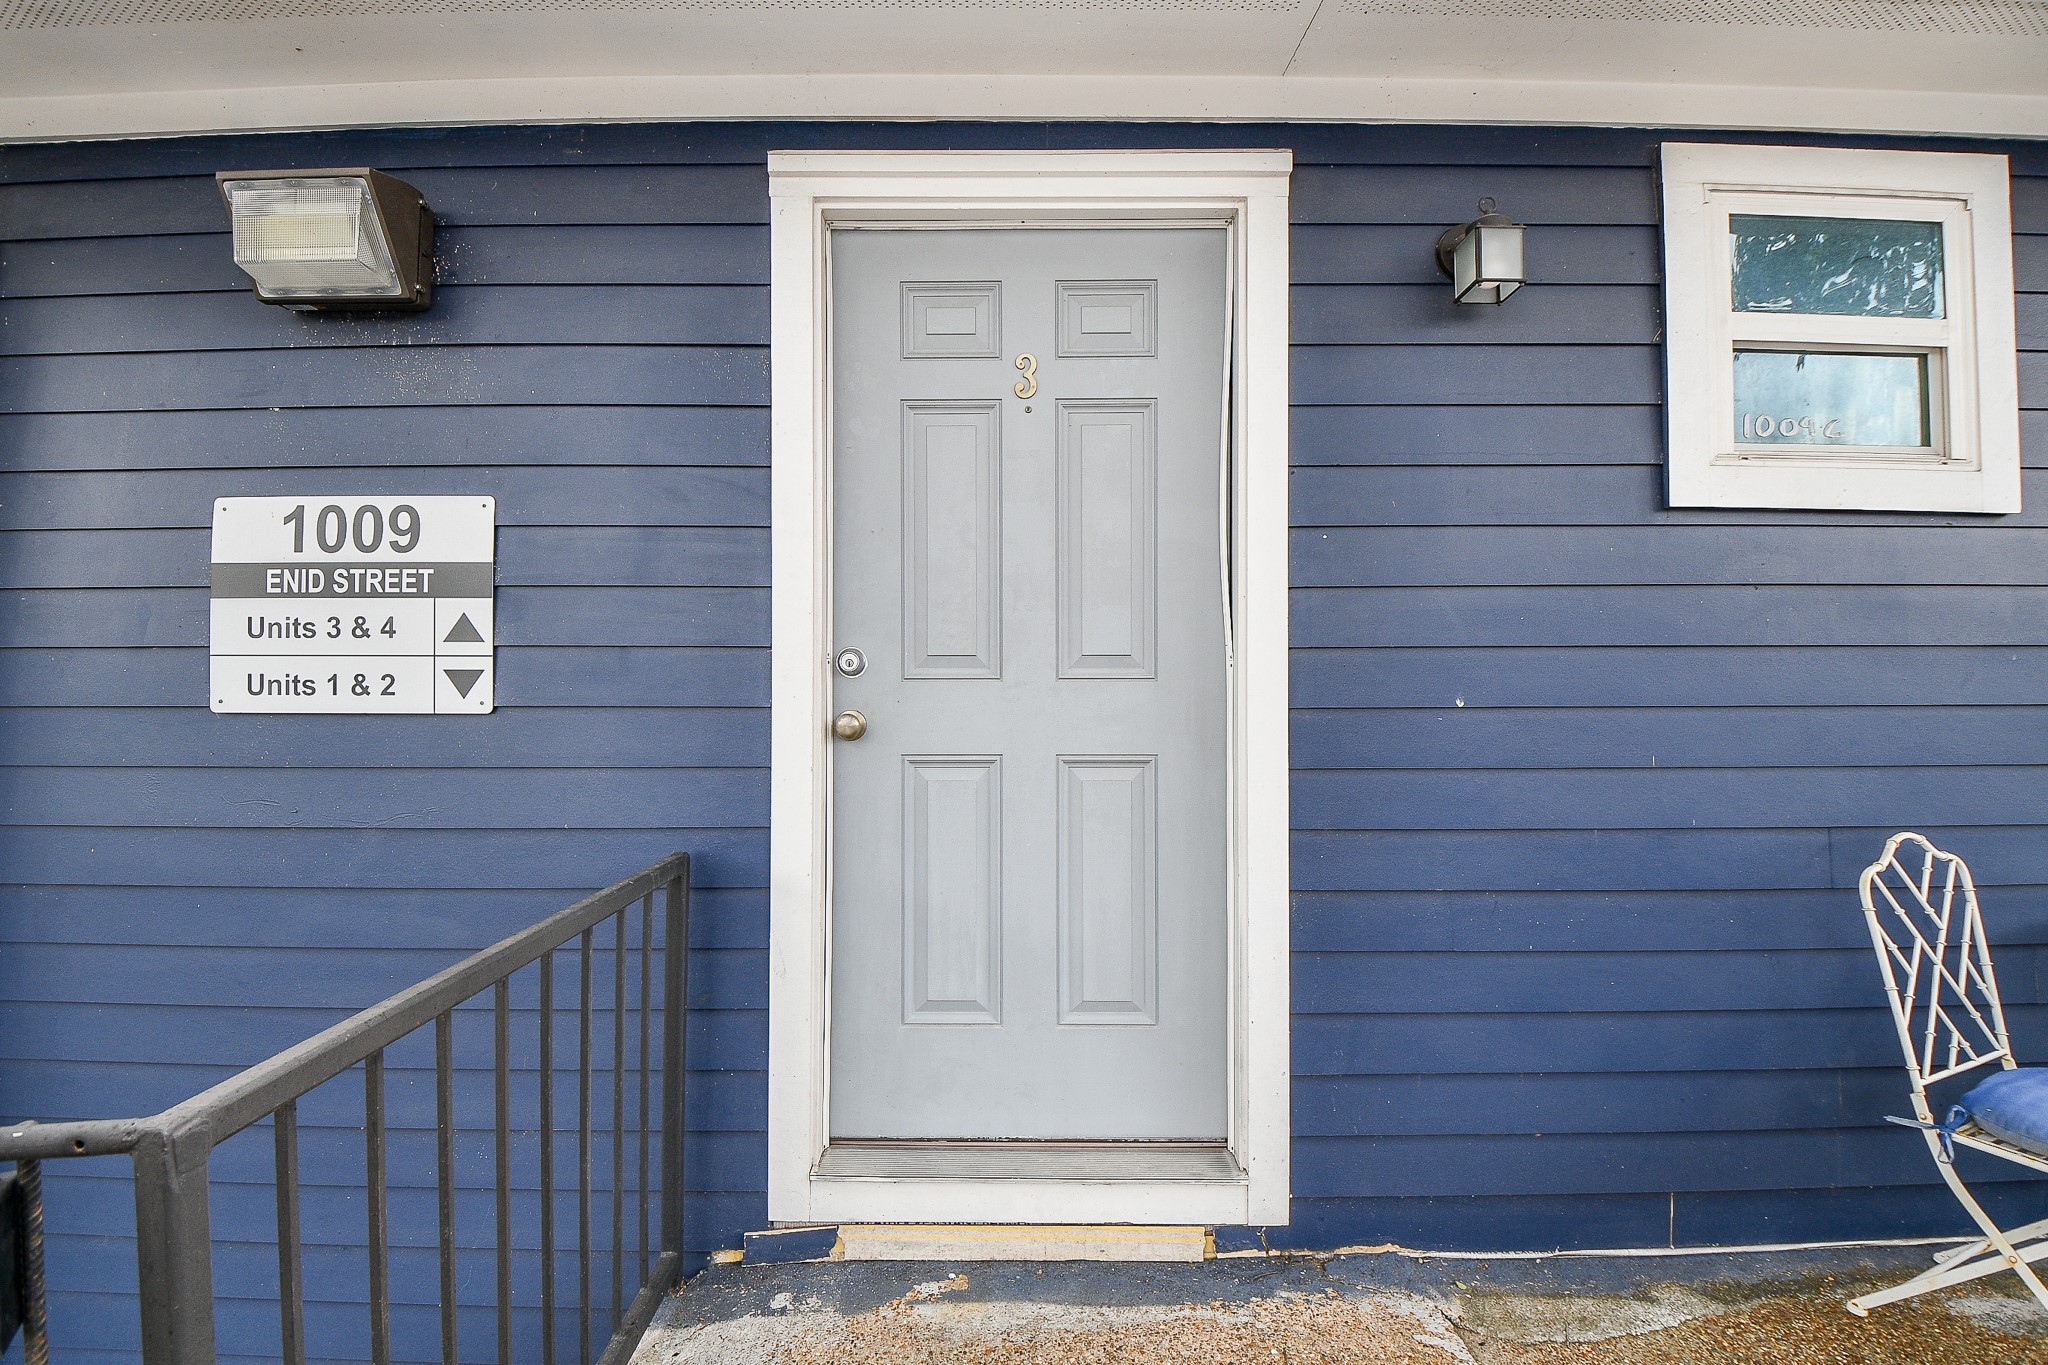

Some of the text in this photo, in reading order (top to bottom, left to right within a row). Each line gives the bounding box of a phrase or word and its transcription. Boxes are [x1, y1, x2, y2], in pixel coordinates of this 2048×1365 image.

[1014, 352, 1037, 399] 3
[283, 504, 421, 553] 1009
[266, 568, 434, 593] ENID STREET
[247, 615, 397, 638] Units 3 & 4
[247, 673, 396, 696] Units 1 & 2
